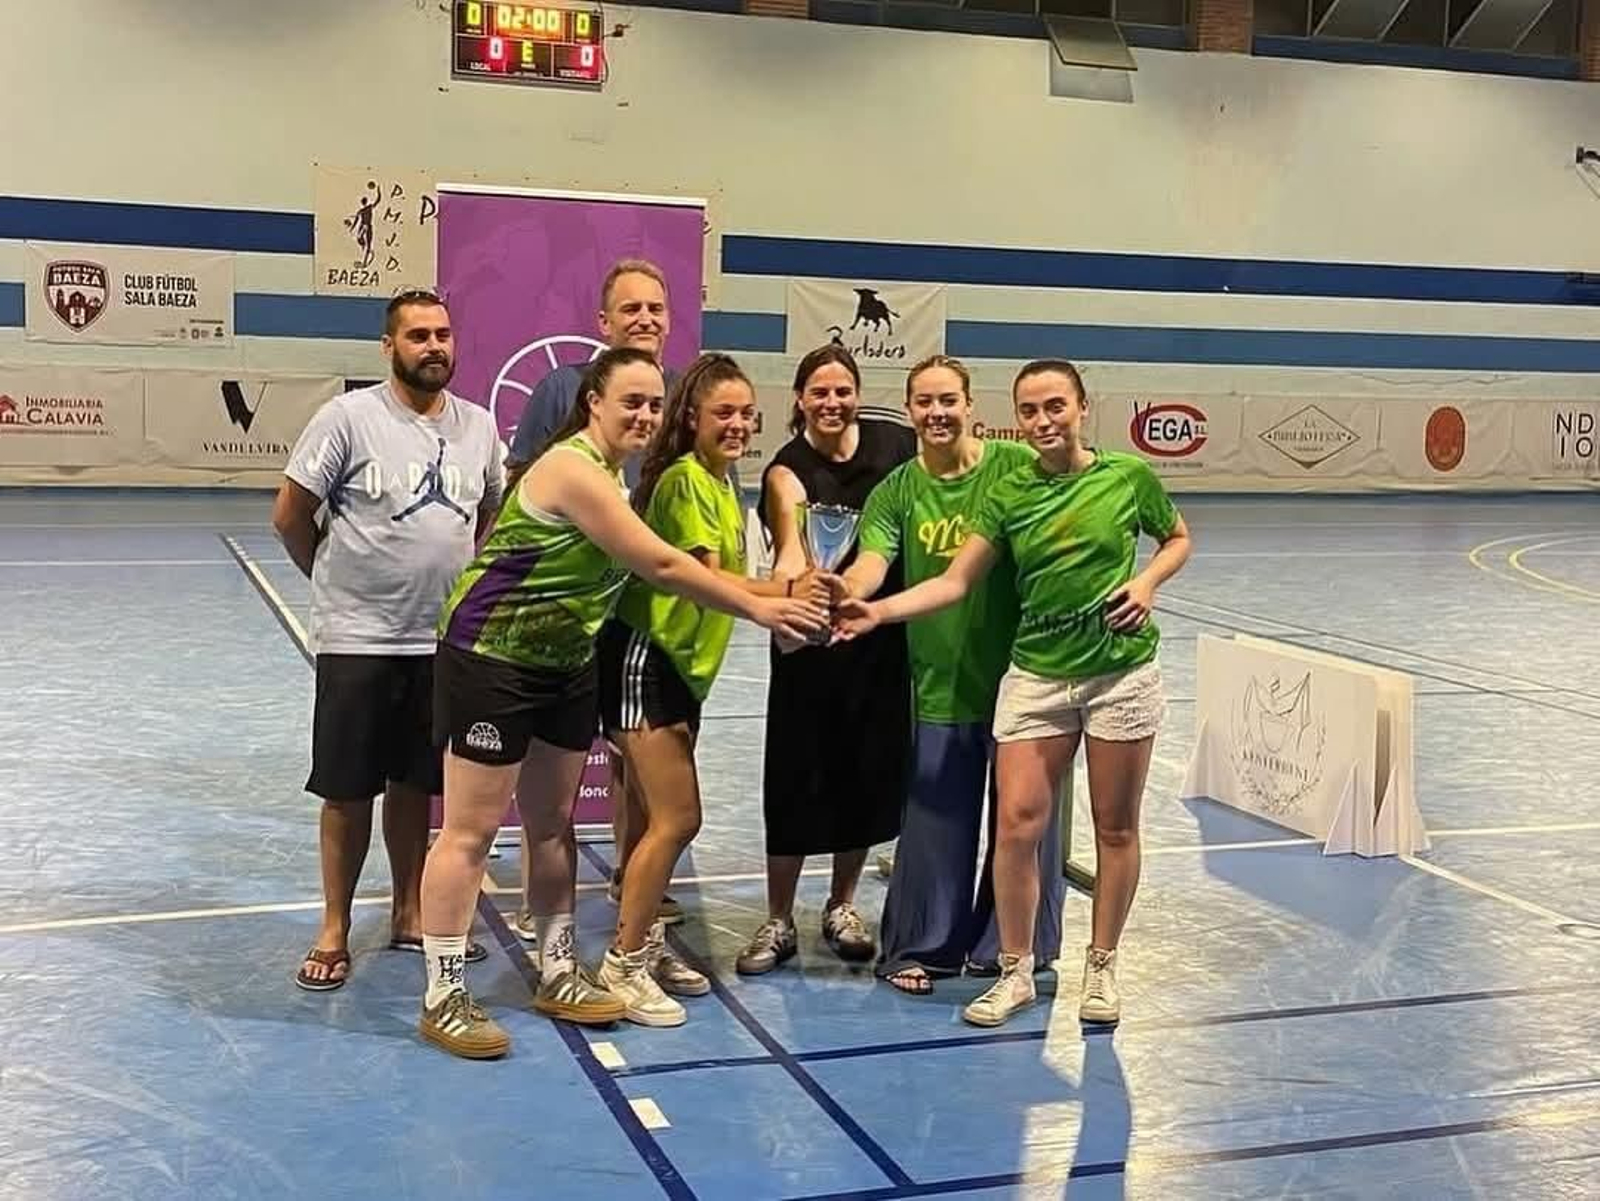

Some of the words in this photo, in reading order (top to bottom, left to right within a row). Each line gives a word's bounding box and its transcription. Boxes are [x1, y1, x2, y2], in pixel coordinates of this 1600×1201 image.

[467, 1, 481, 25] 0
[576, 13, 590, 36] 0
[489, 37, 503, 59] 0
[581, 46, 594, 67] 0
[124, 274, 153, 290] CLUB
[327, 269, 380, 286] BAEZA
[125, 291, 155, 306] SALA
[158, 292, 197, 308] BAEZA
[26, 408, 104, 425] CALAVIA
[1134, 401, 1193, 442] VEGA
